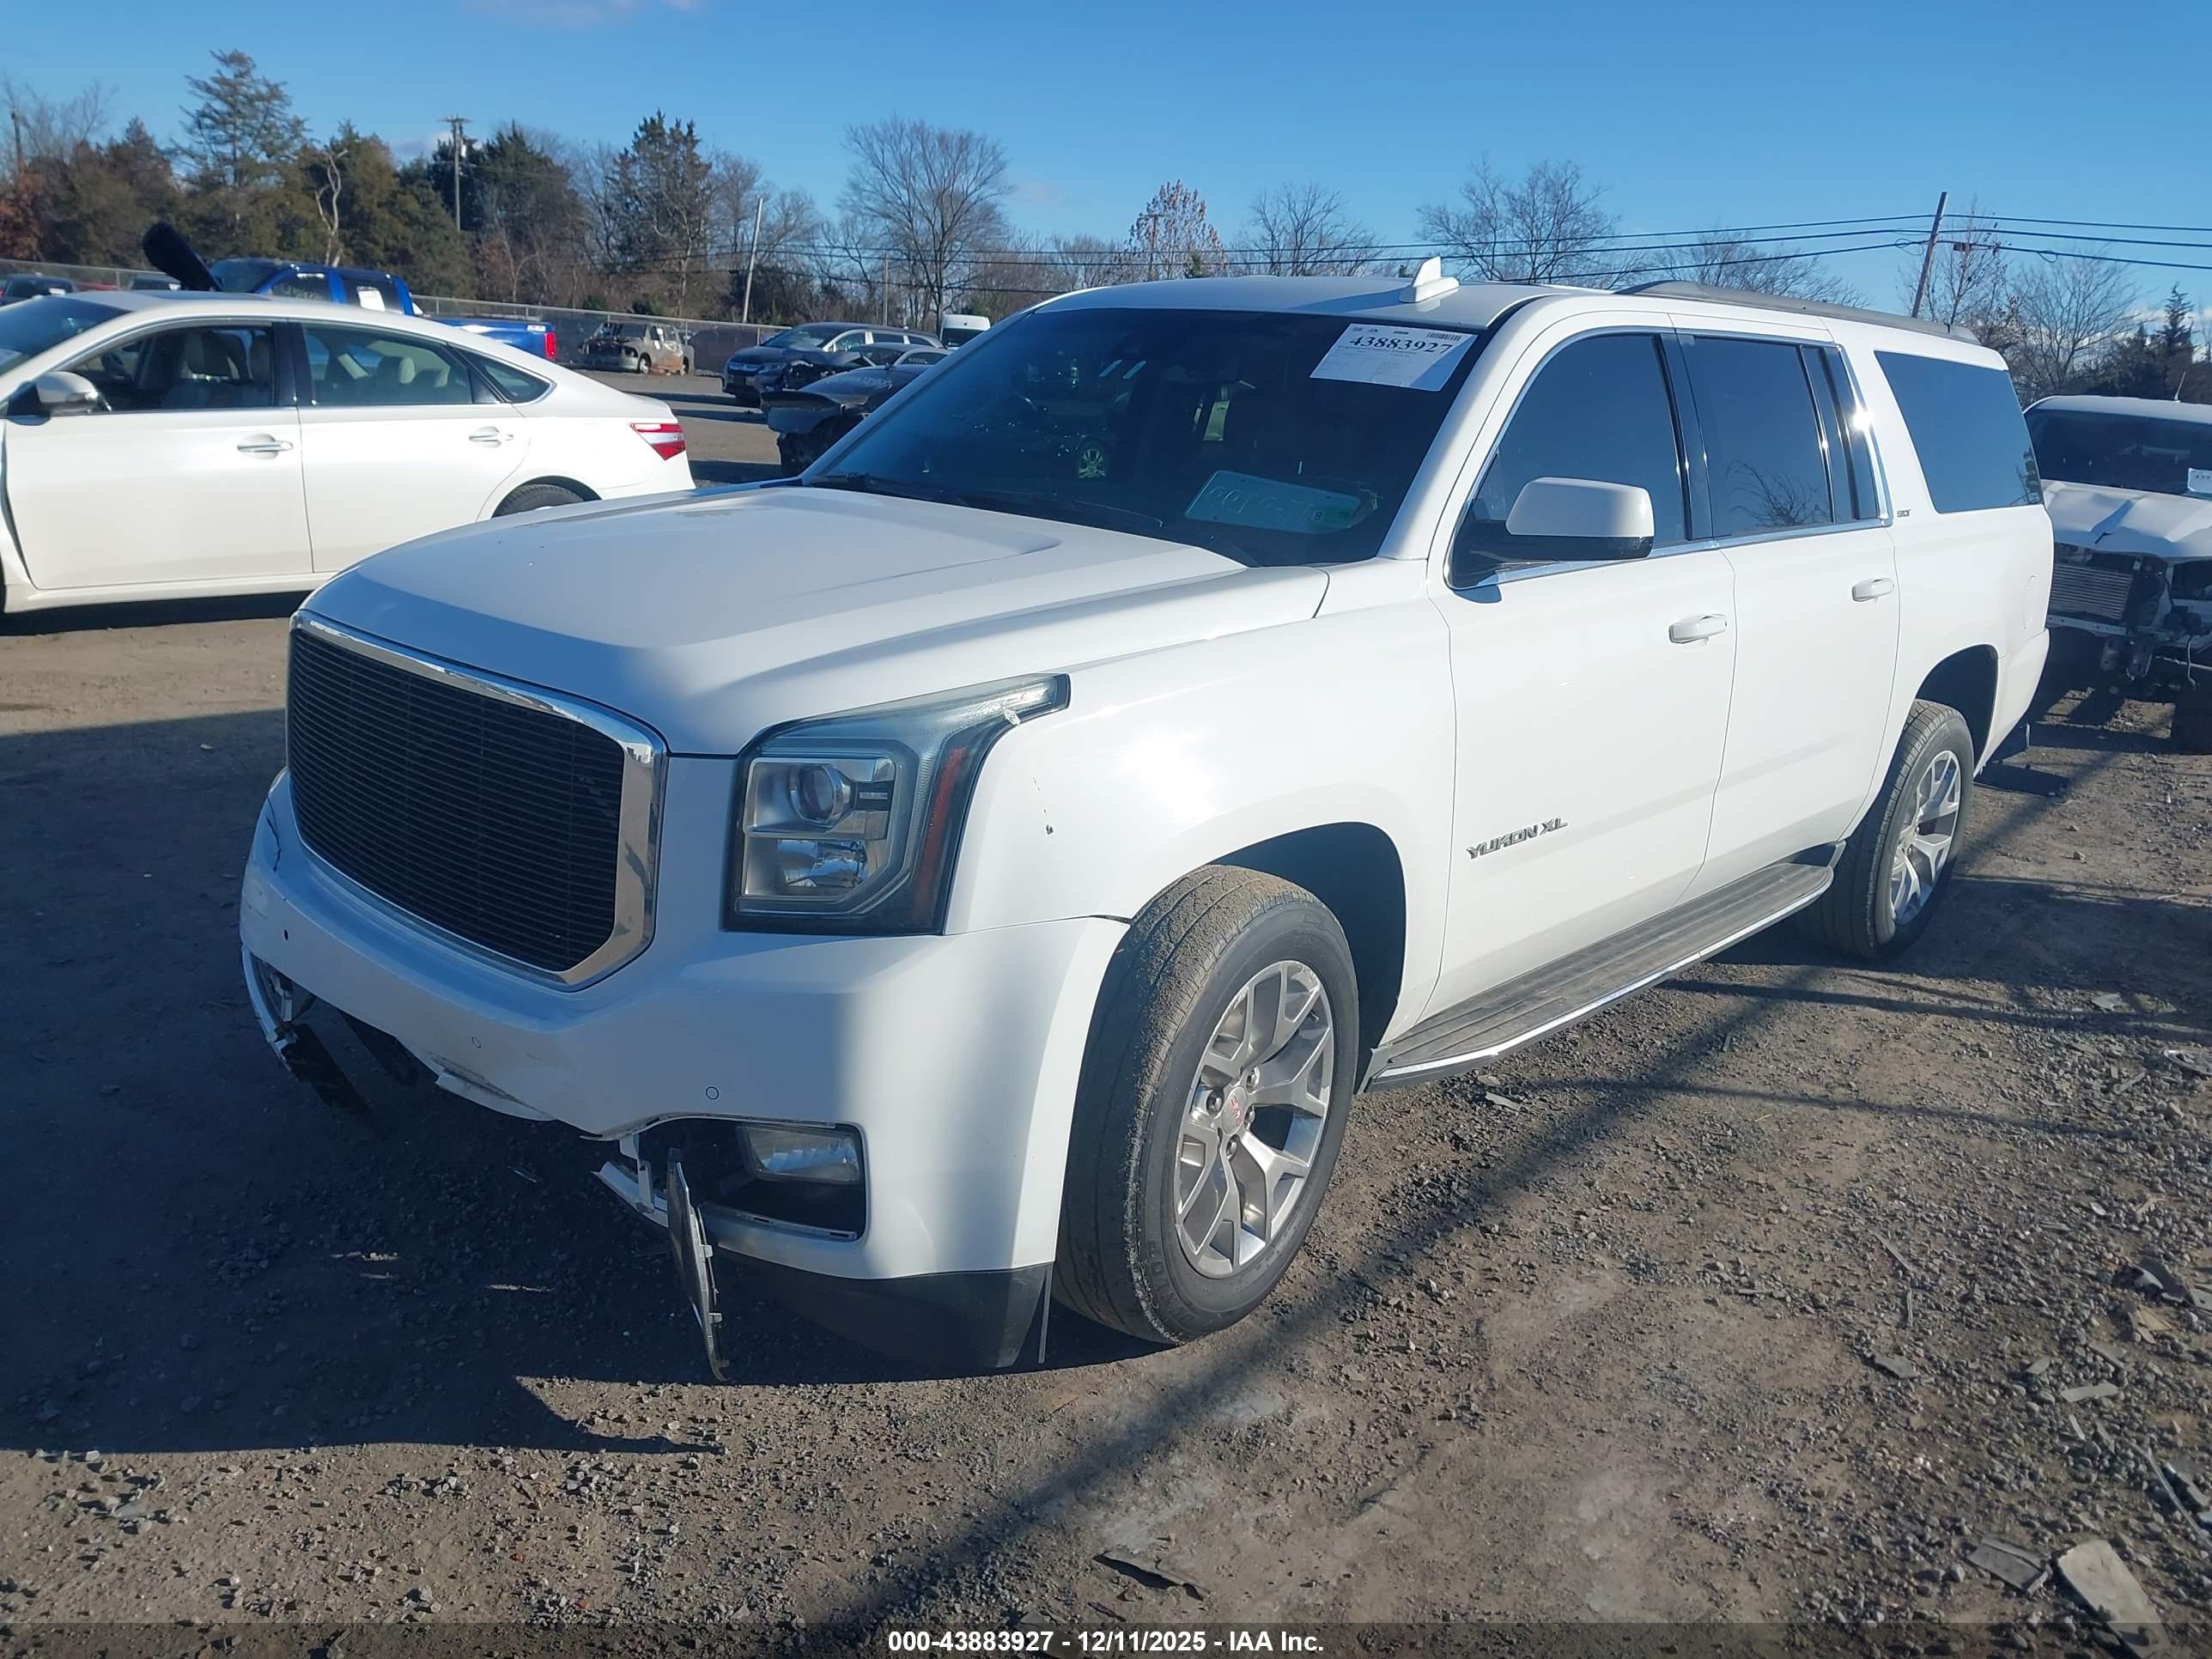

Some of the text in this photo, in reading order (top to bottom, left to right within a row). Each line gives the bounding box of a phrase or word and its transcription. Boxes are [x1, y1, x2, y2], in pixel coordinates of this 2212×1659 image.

[1348, 336, 1453, 355] 43883927
[1466, 817, 1569, 860] YUKON XL
